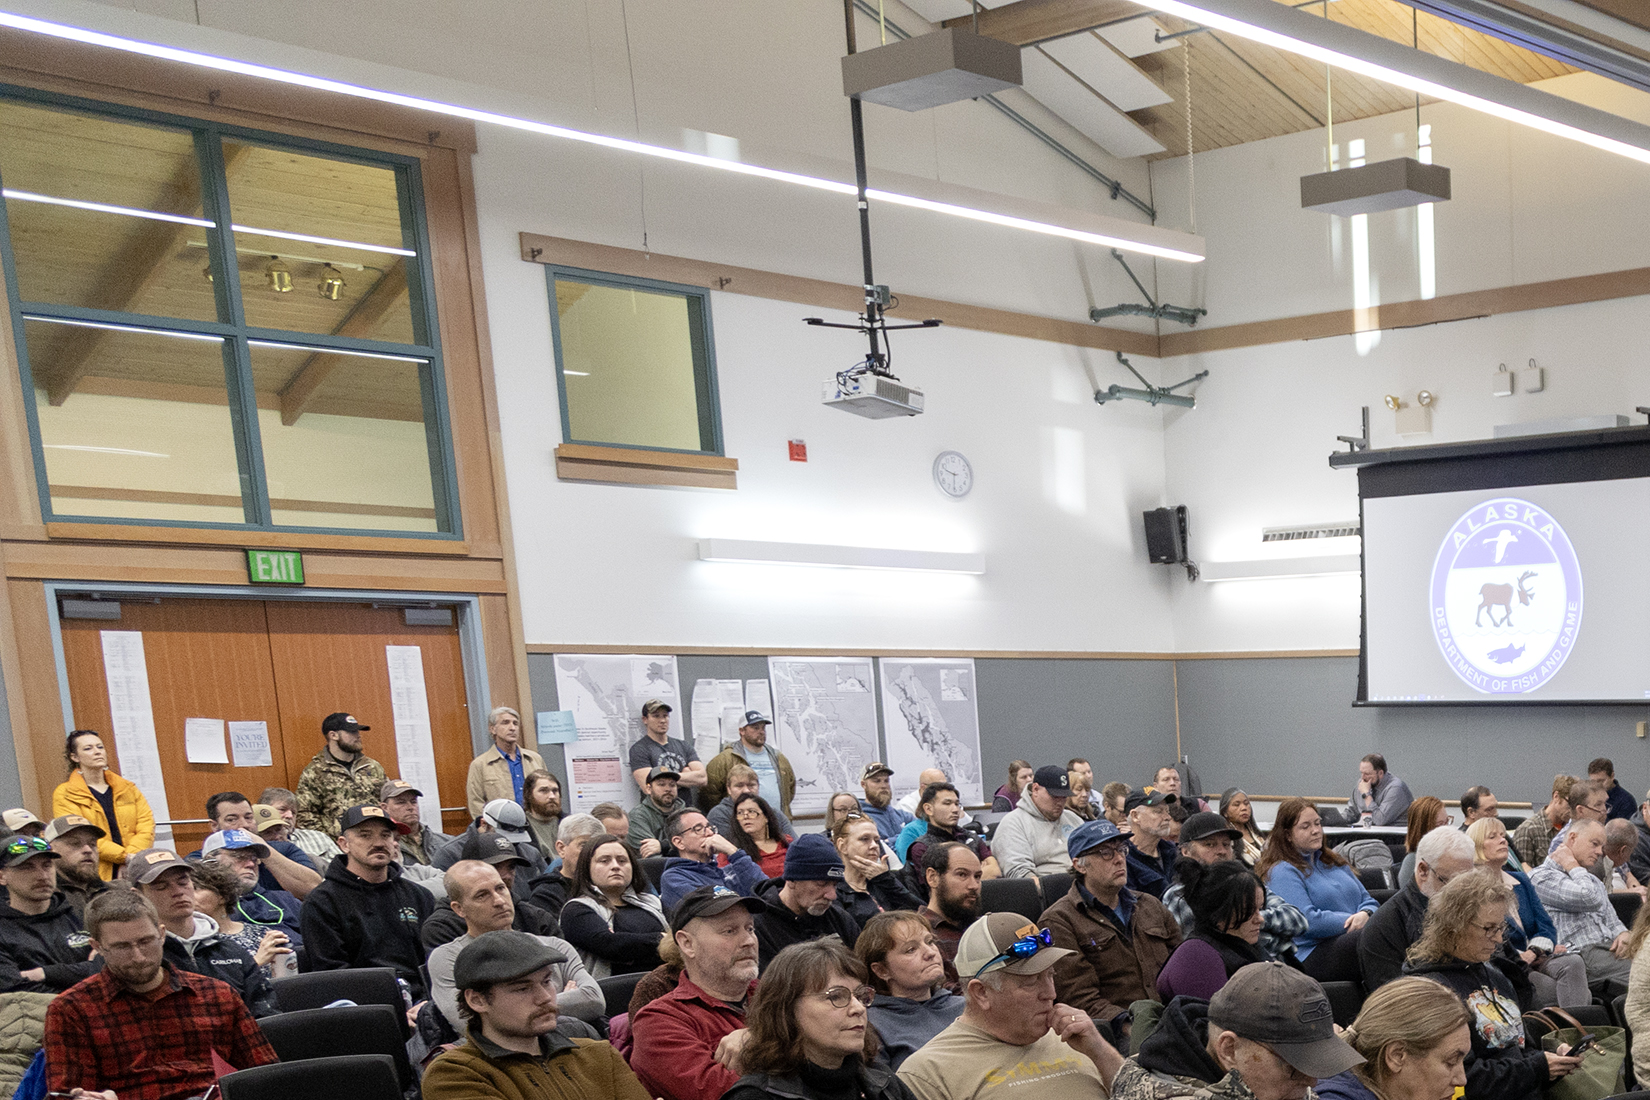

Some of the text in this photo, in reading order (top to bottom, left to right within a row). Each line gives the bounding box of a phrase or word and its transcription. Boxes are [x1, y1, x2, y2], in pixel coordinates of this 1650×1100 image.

[1452, 503, 1556, 550] ALASKA
[255, 553, 296, 581] EXIT
[1434, 600, 1579, 691] DEPARTMENT OF FISH AND GAME
[235, 733, 266, 741] YOU'RE
[235, 741, 268, 749] INVITED
[1060, 775, 1068, 787] S
[1007, 1068, 1079, 1088] FISHING PRODUCTS
